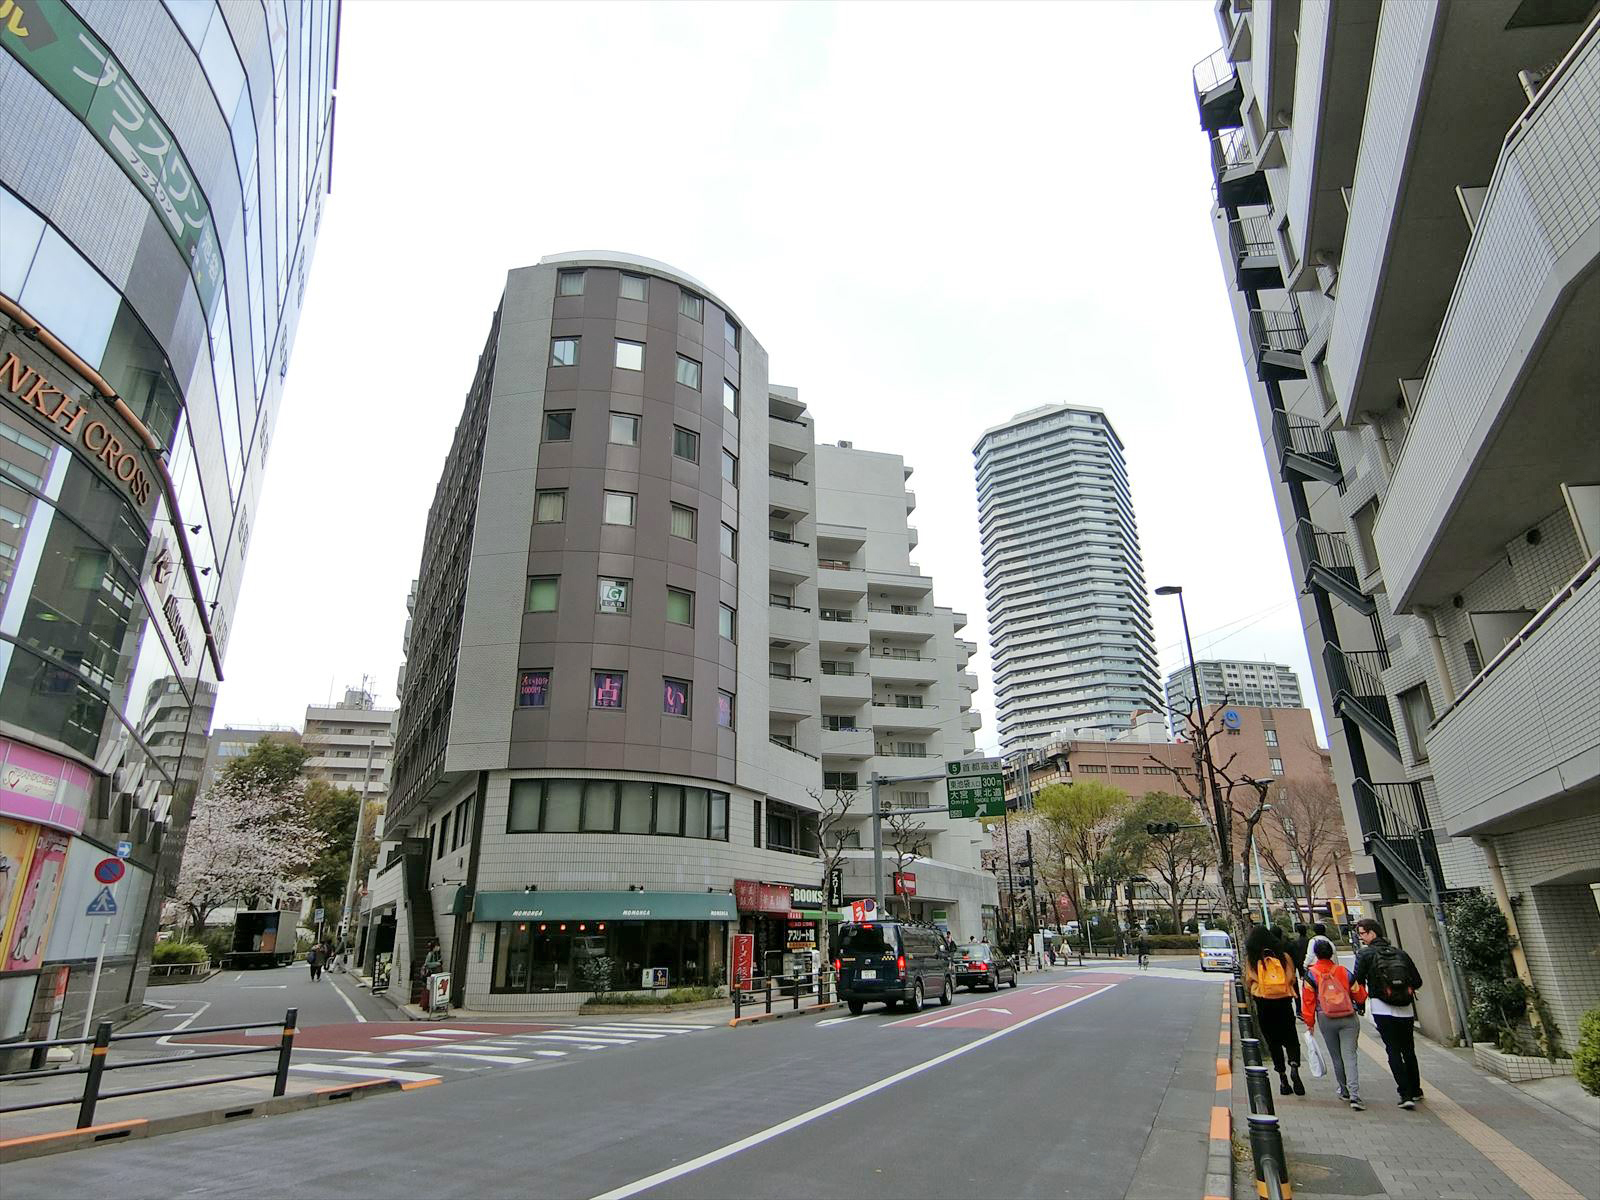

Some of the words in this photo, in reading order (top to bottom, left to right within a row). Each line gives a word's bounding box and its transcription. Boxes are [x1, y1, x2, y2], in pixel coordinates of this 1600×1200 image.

[83, 419, 151, 507] CROSS
[597, 678, 619, 701] 占
[667, 686, 685, 706] い
[950, 790, 968, 799] 大宮
[974, 788, 1002, 798] 東北道
[793, 888, 823, 904] BOOKS
